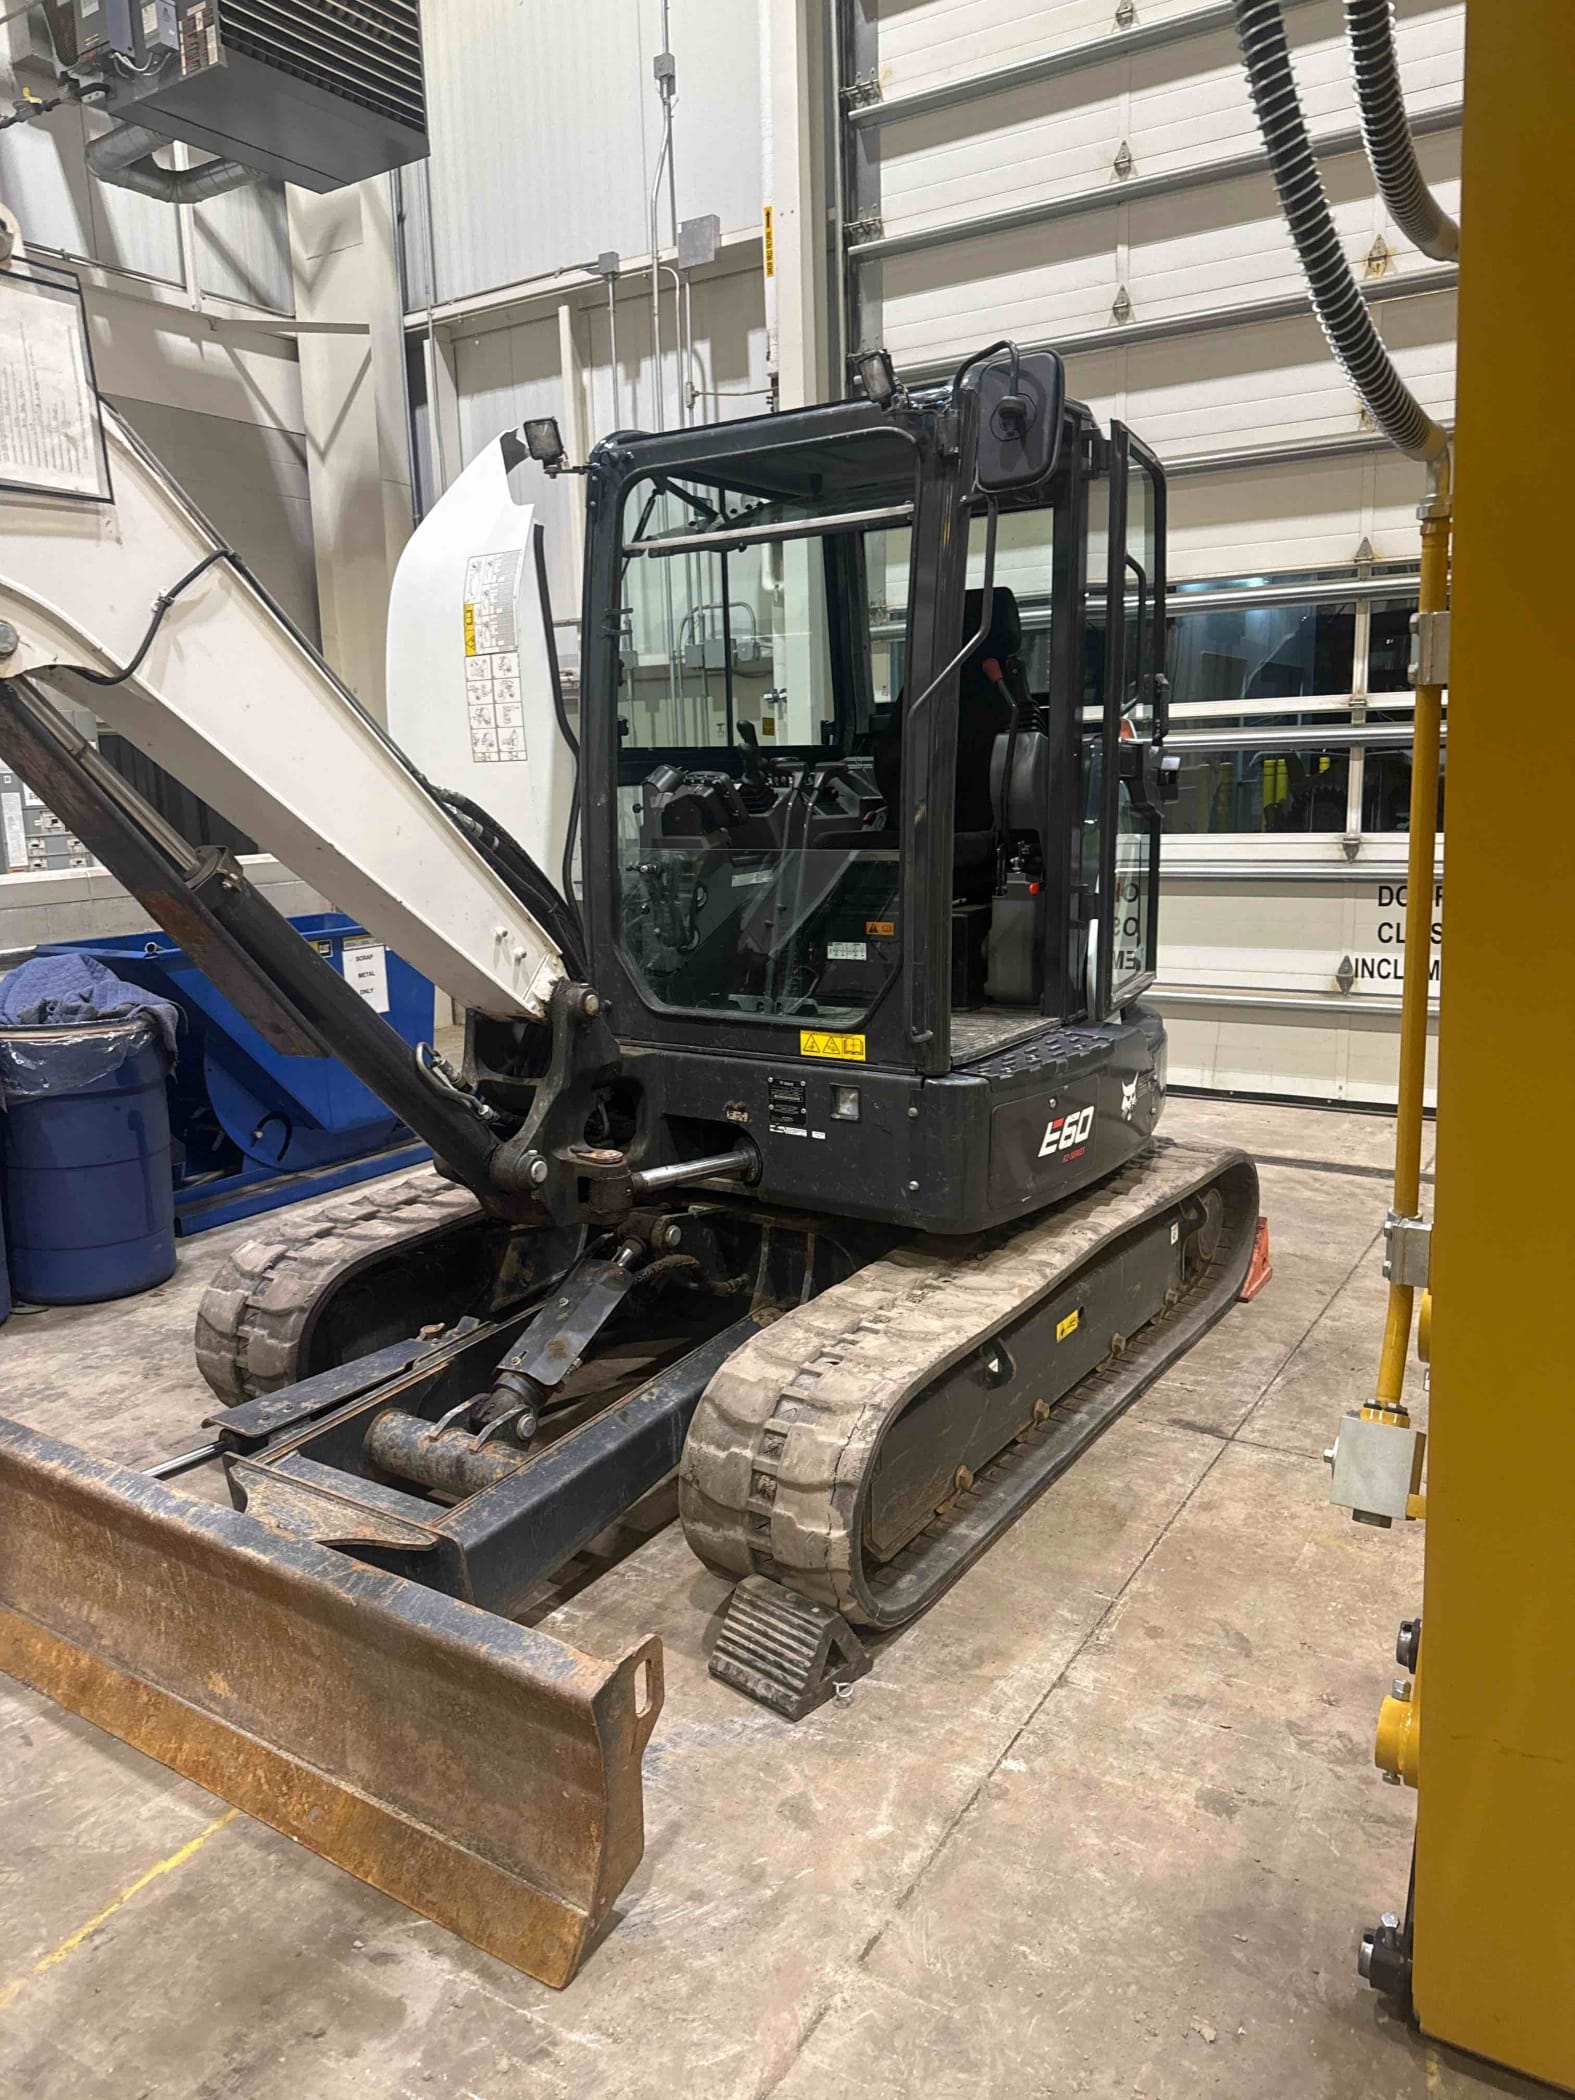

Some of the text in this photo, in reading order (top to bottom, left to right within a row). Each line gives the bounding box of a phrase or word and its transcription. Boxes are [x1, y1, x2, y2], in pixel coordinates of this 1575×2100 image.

[1377, 885, 1443, 907] DO
[1377, 922, 1442, 944] CLS
[358, 971, 375, 979] METAL
[1038, 1105, 1095, 1157] E60
